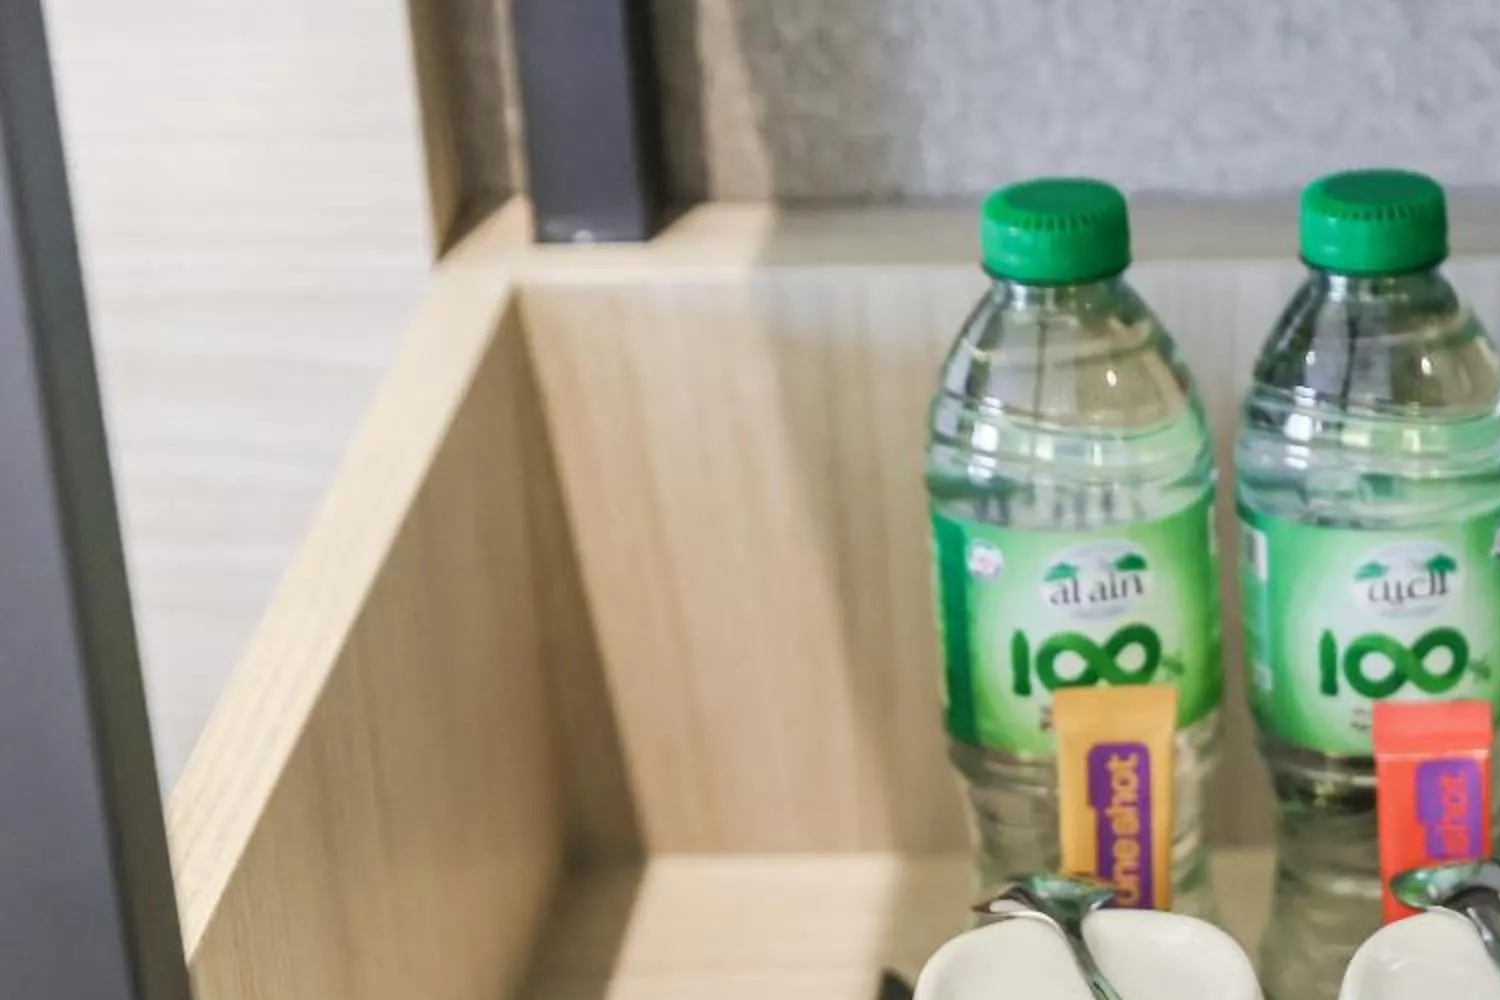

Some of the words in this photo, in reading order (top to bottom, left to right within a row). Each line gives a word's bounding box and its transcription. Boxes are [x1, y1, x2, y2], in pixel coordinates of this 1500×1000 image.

[1010, 622, 1162, 697] 100
[1318, 626, 1470, 698] 100
[1105, 752, 1140, 836] shot
